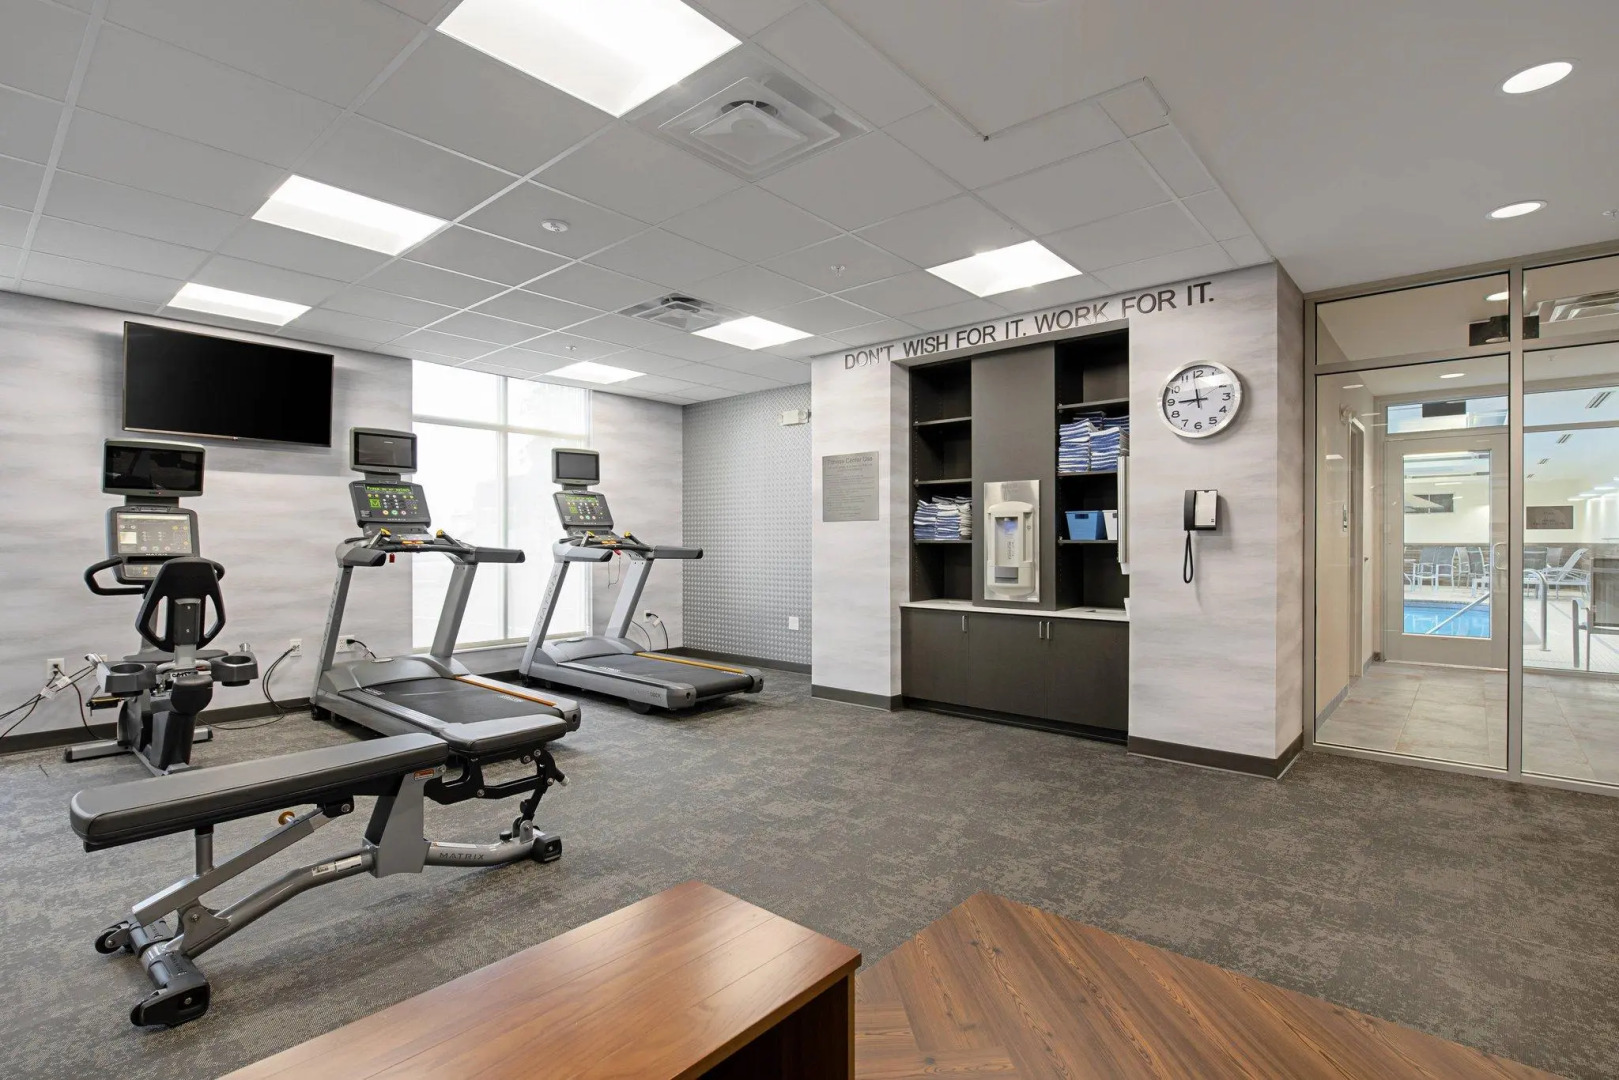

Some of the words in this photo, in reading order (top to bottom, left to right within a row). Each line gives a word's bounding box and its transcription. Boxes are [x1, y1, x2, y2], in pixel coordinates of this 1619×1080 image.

[844, 345, 894, 370] DON'T
[903, 335, 949, 358] WISH
[956, 324, 996, 349] FOR
[1005, 318, 1027, 340] IT.
[1034, 302, 1109, 335] WORK
[1121, 289, 1177, 318] FOR
[1187, 281, 1214, 306] IT.
[1193, 370, 1204, 378] 12
[1171, 386, 1180, 394] 10
[439, 852, 484, 860] MATRIX
